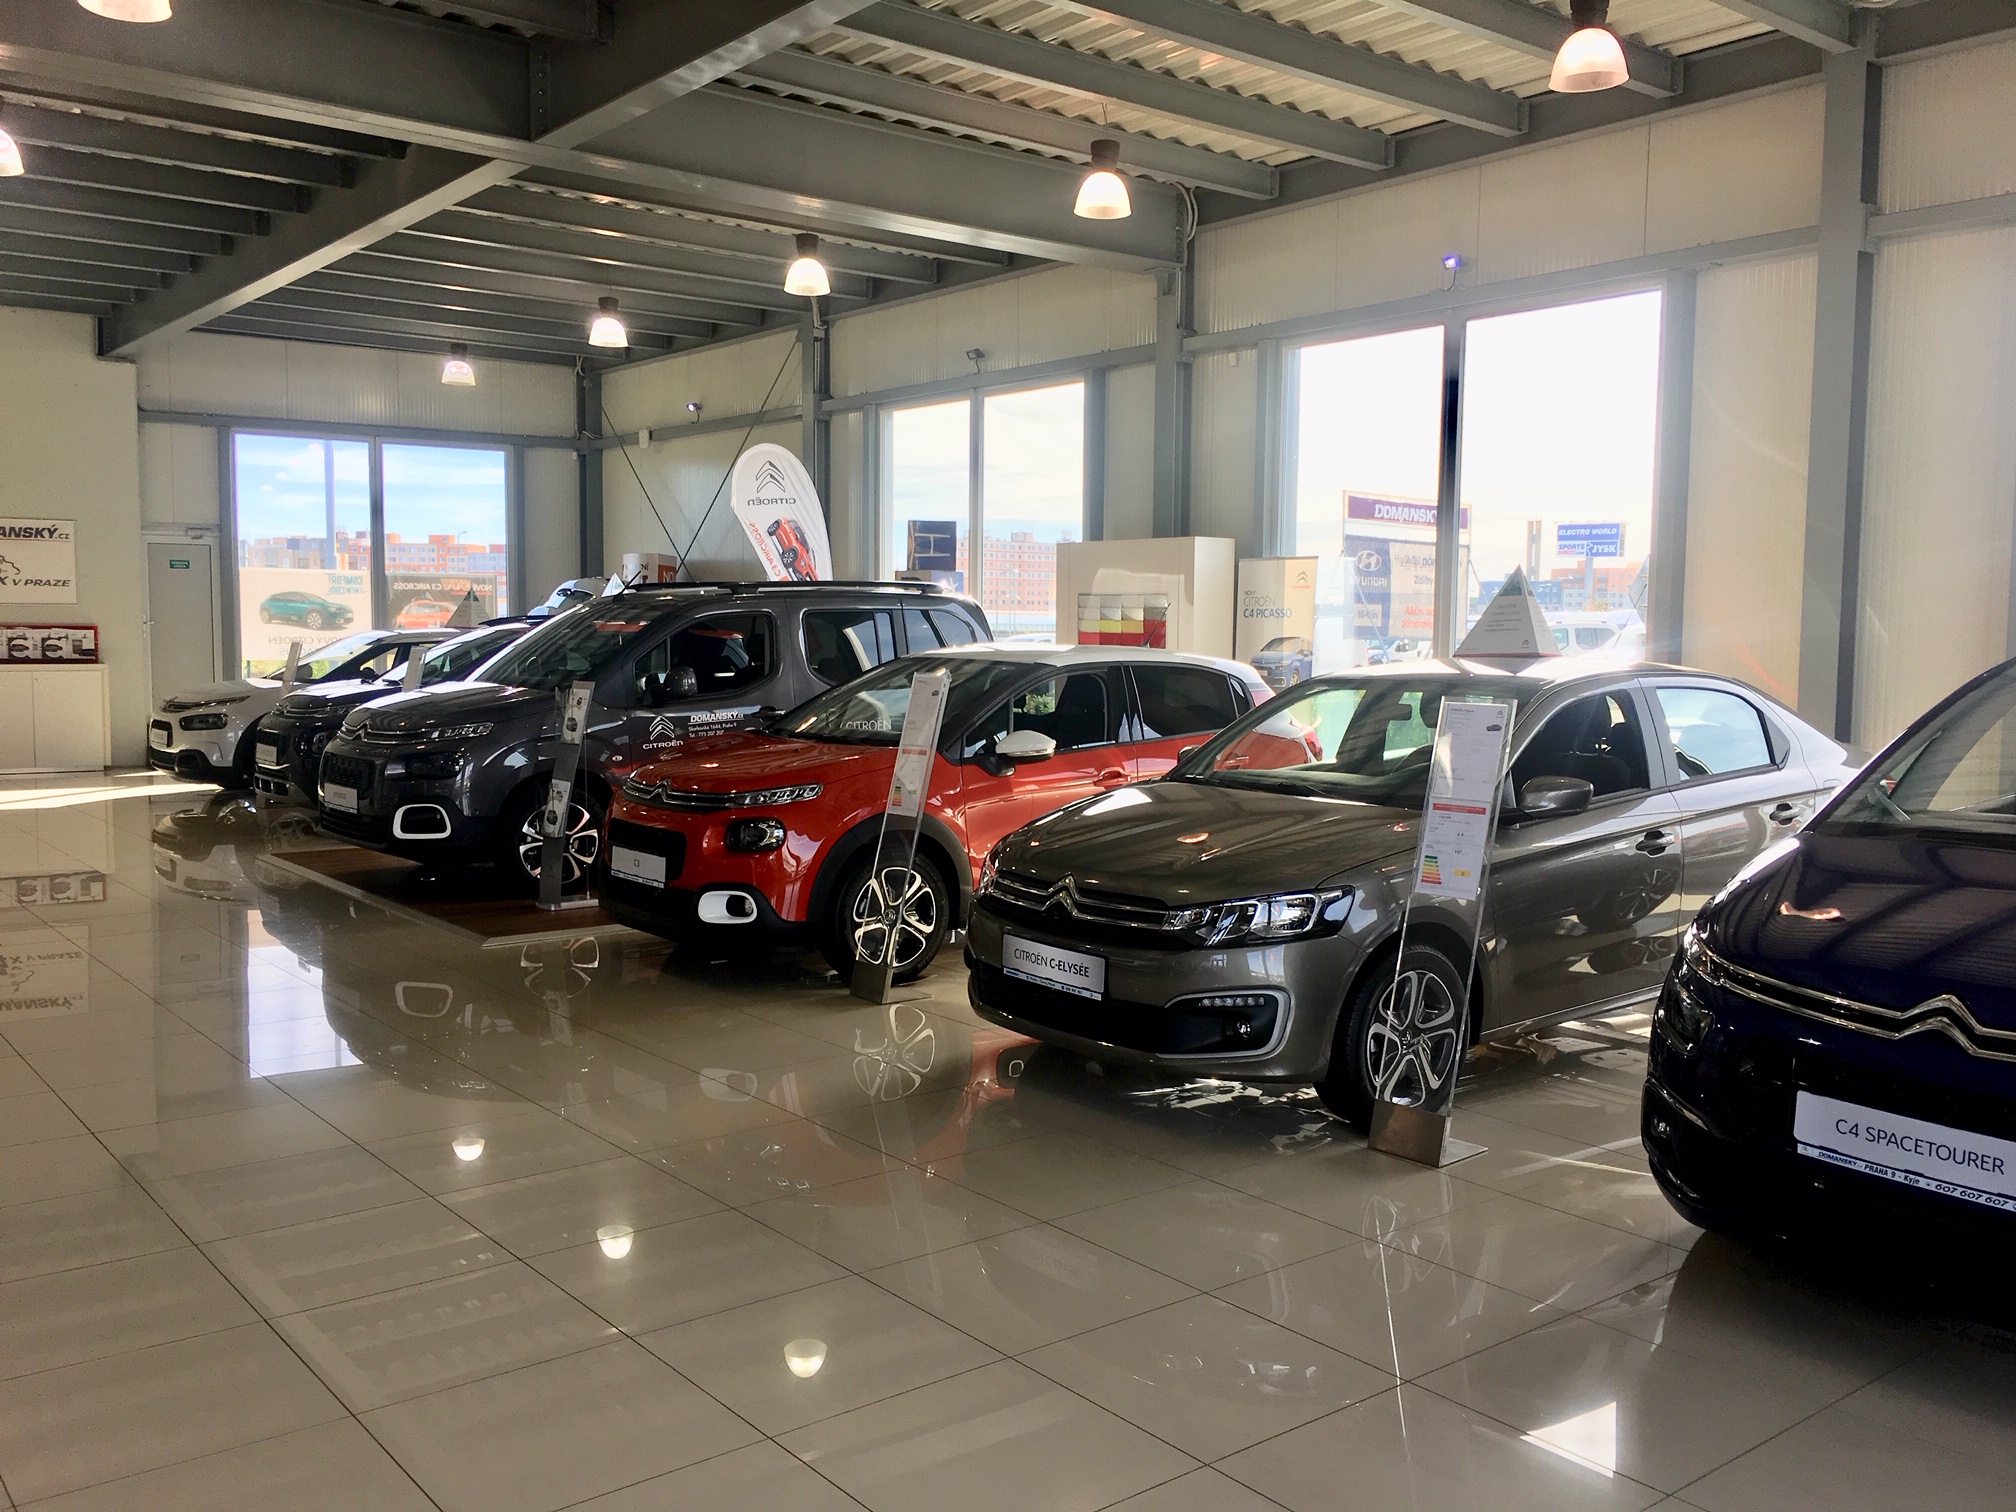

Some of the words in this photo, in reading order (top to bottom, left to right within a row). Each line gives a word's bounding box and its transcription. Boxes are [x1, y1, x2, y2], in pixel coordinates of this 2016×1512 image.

[1592, 544, 1617, 553] JYSK
[24, 579, 71, 587] PRAZE
[1243, 608, 1254, 618] C4
[1256, 608, 1292, 619] PICASSO
[846, 719, 892, 731] CITROËN
[1014, 948, 1048, 967] CITROËN
[1049, 958, 1090, 978] C-ELYSÉE
[1835, 1118, 1860, 1138] C4
[1865, 1126, 2005, 1176] SPACETOURER
[1864, 1163, 1889, 1177] PRAHA
[1890, 1171, 1897, 1179] 9
[1903, 1174, 1921, 1186] Kyje
[1935, 1183, 1958, 1195] 607
[1959, 1189, 1983, 1201] 607
[1984, 1196, 2009, 1208] 607
